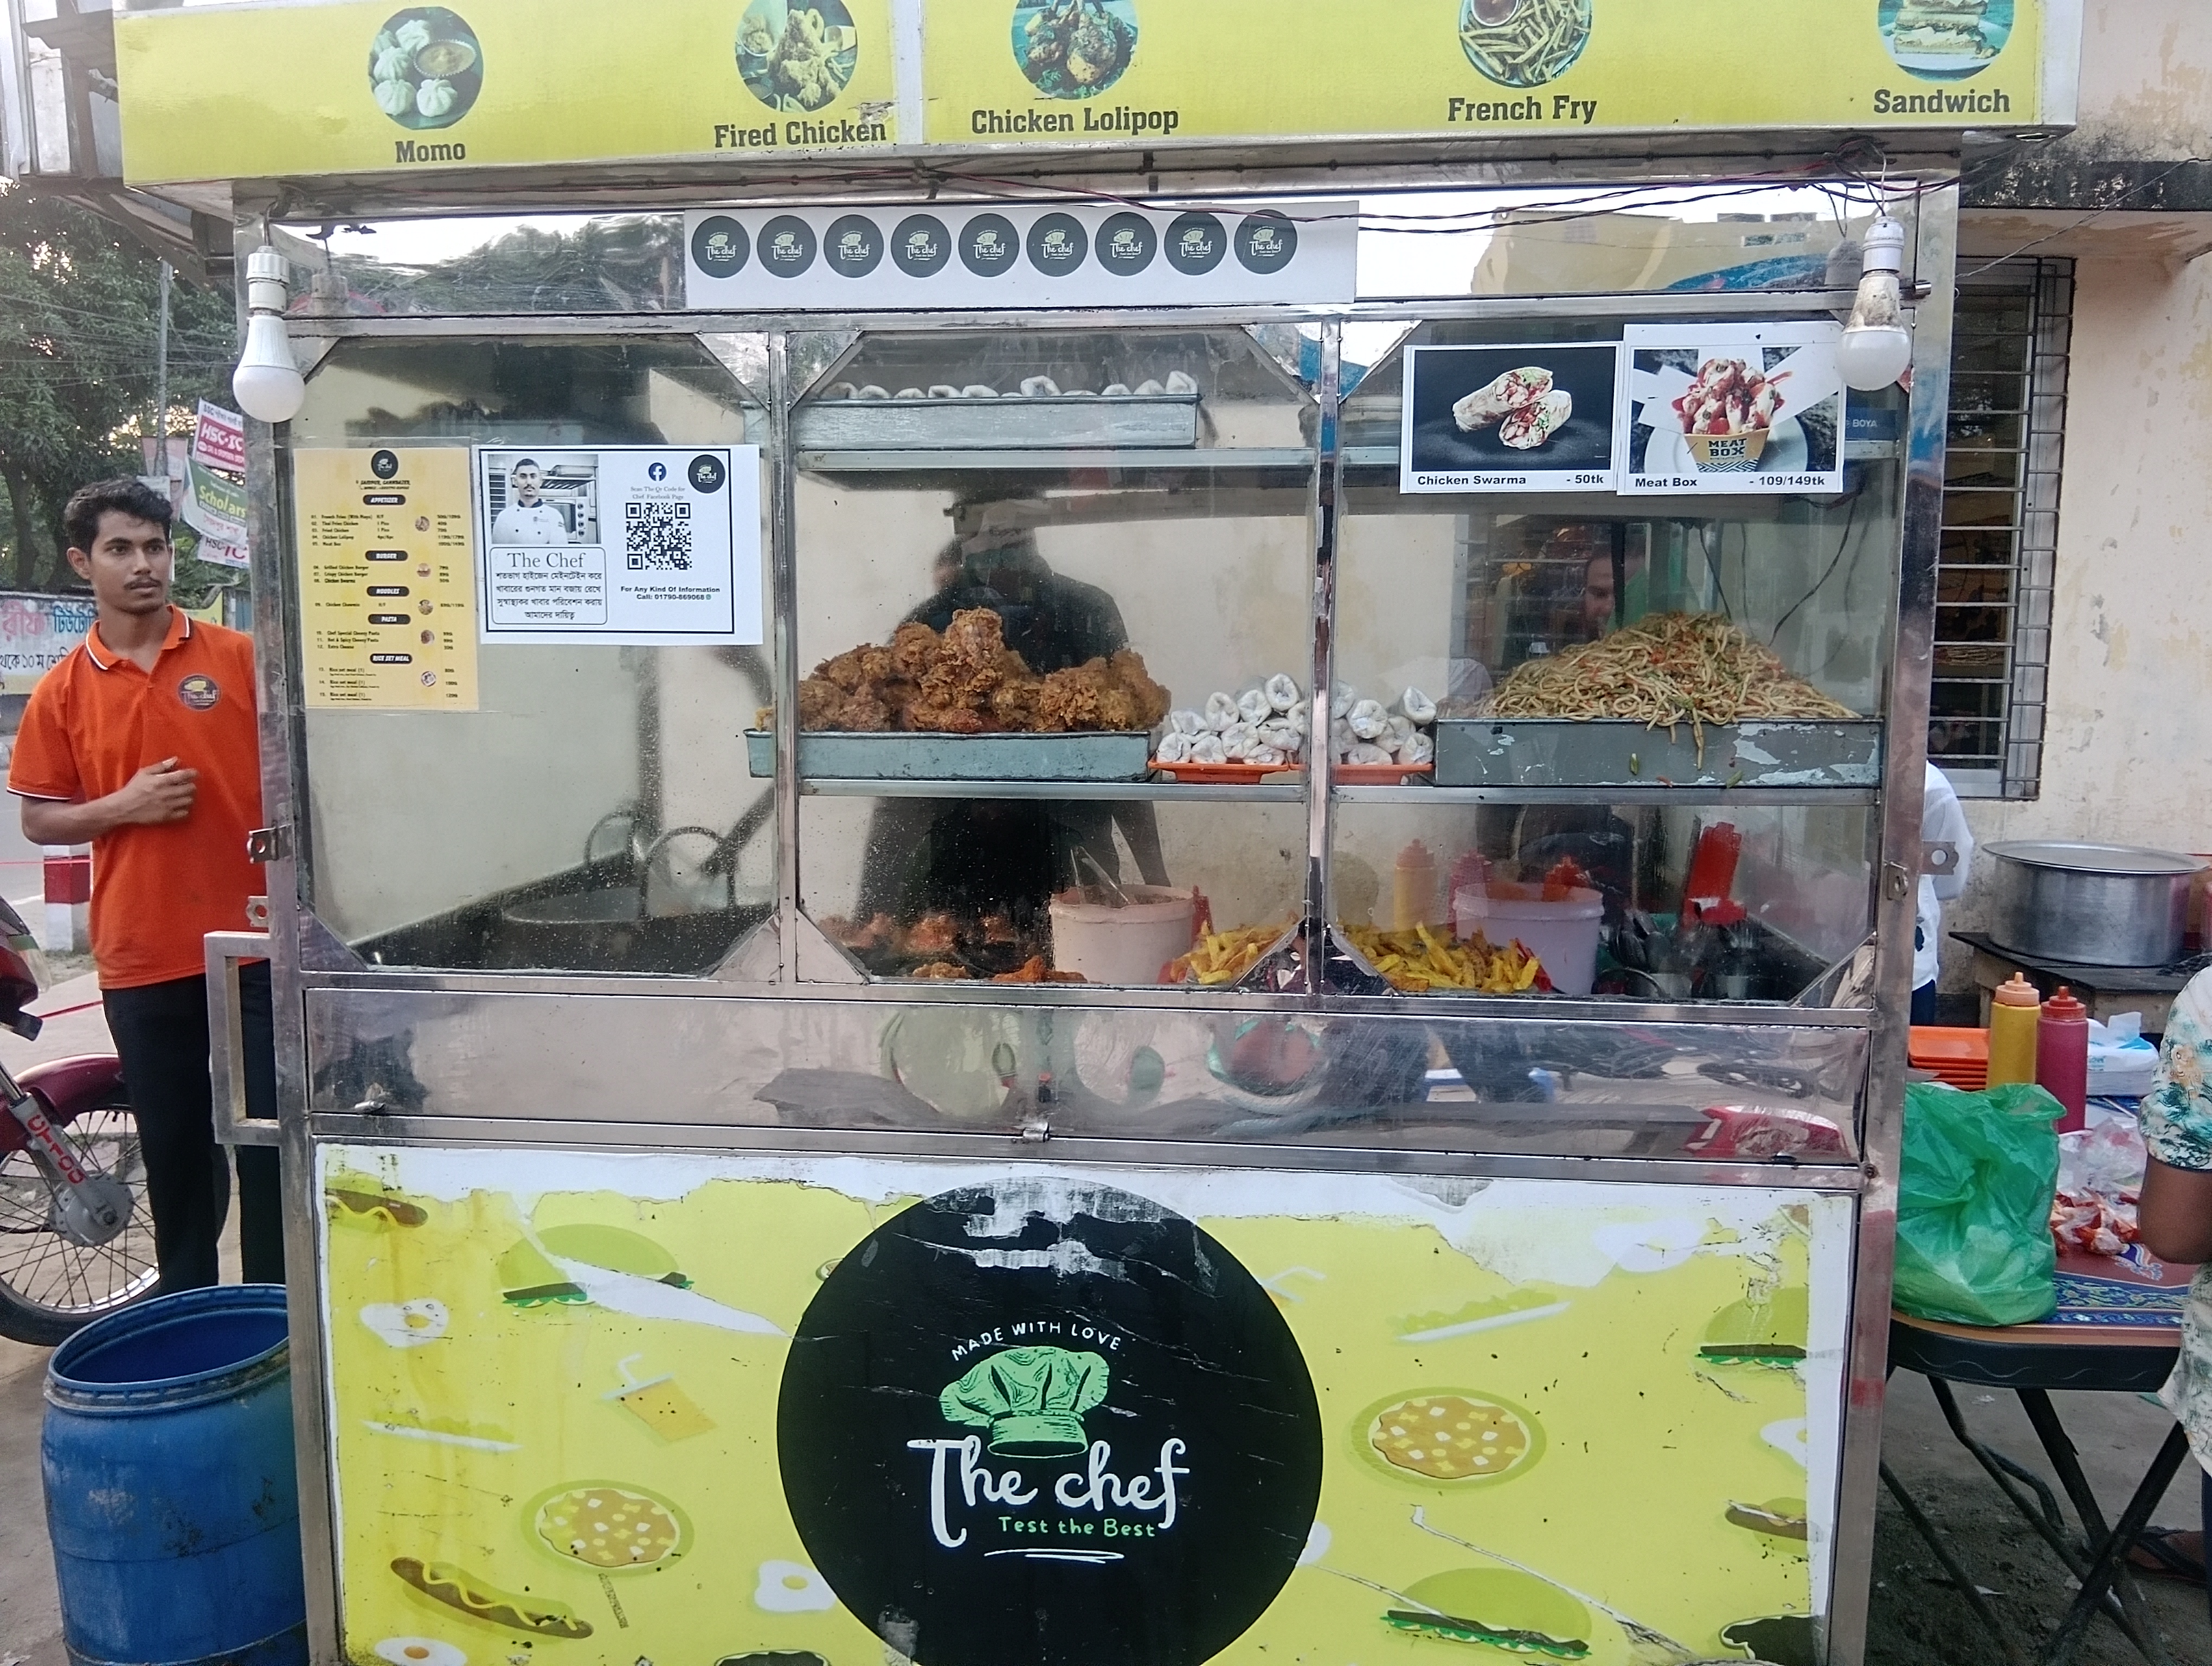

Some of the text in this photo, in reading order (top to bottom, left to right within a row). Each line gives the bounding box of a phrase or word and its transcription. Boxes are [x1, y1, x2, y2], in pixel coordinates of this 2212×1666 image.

[1874, 89, 2010, 114] Sandwich
[1448, 95, 1597, 125] French Fry
[972, 106, 1178, 135] Chicken Lolipop
[715, 119, 886, 148] Fired Chicken
[395, 141, 466, 163] Momo
[705, 245, 737, 260] The chef
[771, 245, 803, 260] The chef
[838, 245, 870, 260] The chef
[905, 244, 937, 259] The chef
[973, 243, 1006, 259] The chef
[1041, 243, 1074, 258] The chef
[1110, 242, 1142, 258] The chef
[1179, 241, 1212, 257] The chef
[1249, 239, 1283, 255] The chef
[1853, 419, 1877, 427] BOYA
[1708, 438, 1747, 447] MEAT
[1710, 446, 1745, 456] BOX
[1418, 475, 1469, 485] Chicken
[1474, 475, 1526, 484] Swarma
[1575, 475, 1604, 484] 50tk
[1635, 478, 1668, 487] Meat
[1673, 477, 1697, 486] Box
[1759, 476, 1825, 485] 109/149tk
[199, 485, 246, 517] Scholars
[507, 552, 586, 567] The Chef
[951, 1321, 1121, 1361] MADE WITH LOVE
[906, 1434, 1190, 1548] The chef
[998, 1516, 1155, 1537] Test the Best
